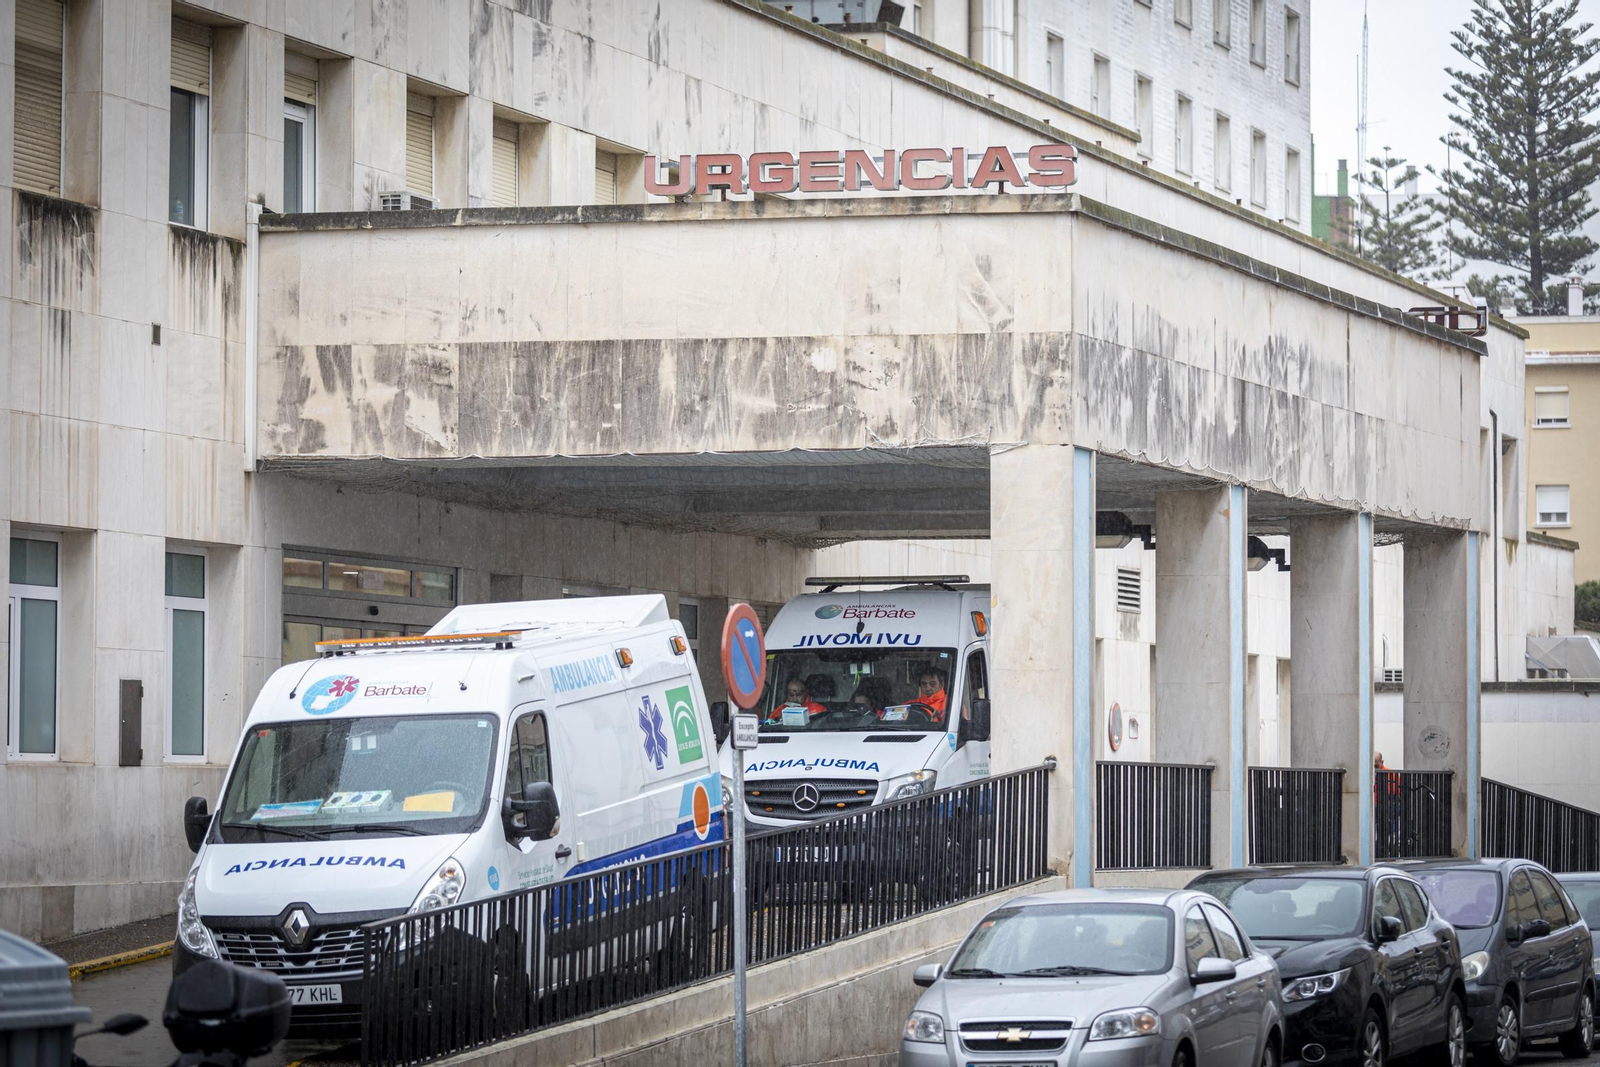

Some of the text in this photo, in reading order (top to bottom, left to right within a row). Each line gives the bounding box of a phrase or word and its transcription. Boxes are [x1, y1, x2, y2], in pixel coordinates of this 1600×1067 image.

[644, 143, 1078, 197] URGENCIAS
[842, 608, 916, 619] Barbate
[549, 655, 617, 693] AMBULANCIA
[364, 684, 427, 697] Barbate
[287, 987, 338, 1002] 77 KHL
